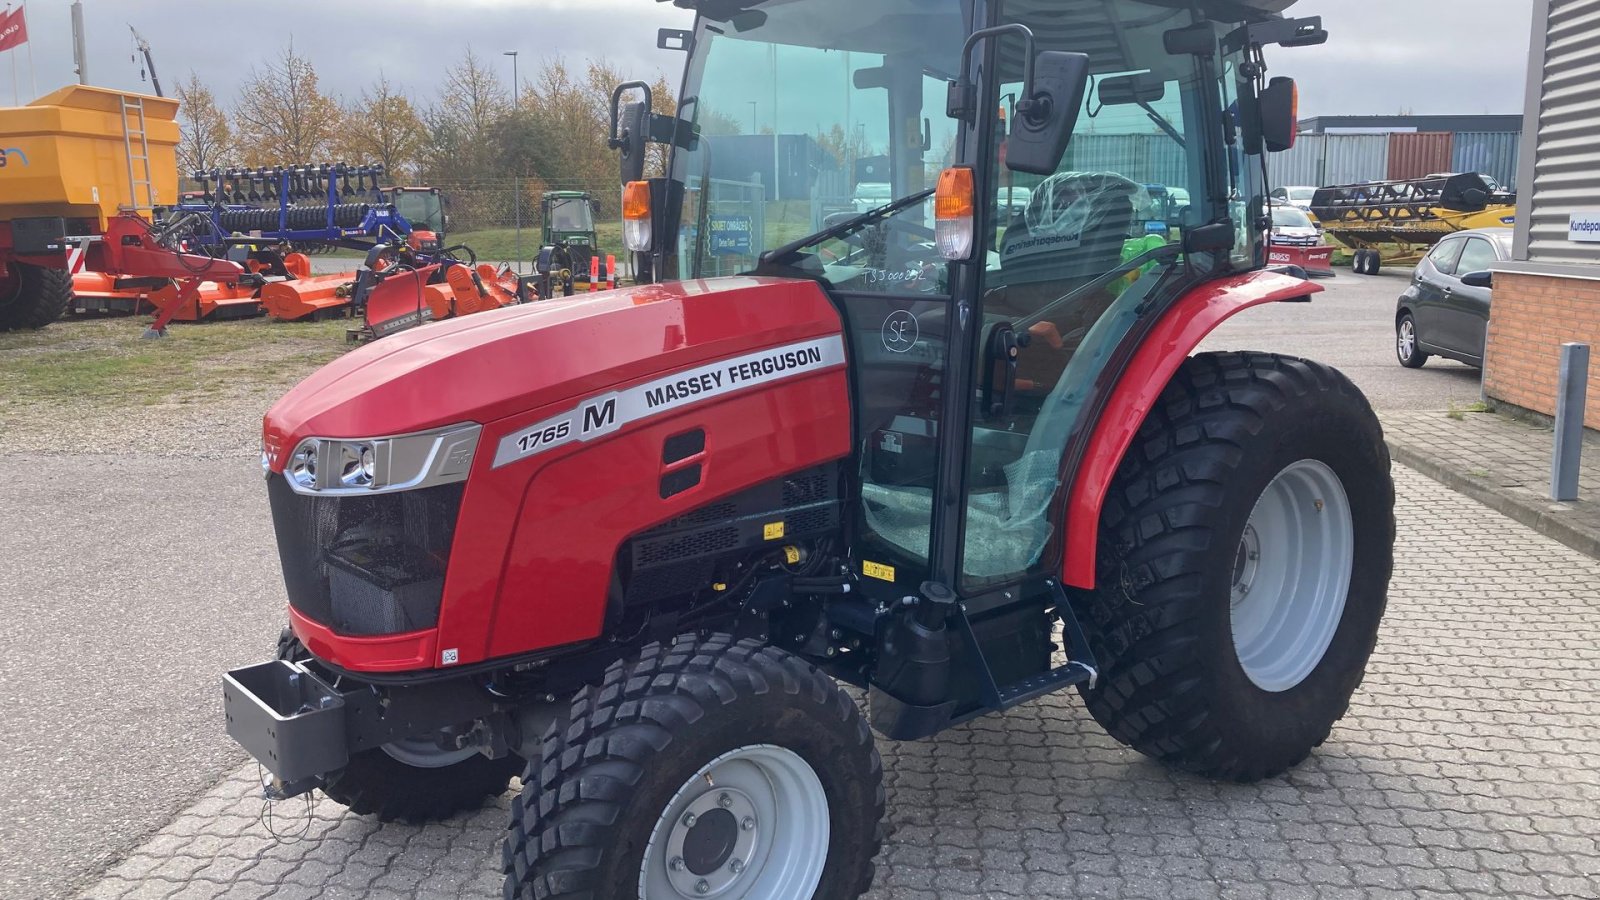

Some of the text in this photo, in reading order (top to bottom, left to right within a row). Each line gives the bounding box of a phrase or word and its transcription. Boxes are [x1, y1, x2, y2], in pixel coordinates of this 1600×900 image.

[1570, 219, 1600, 235] Kundepa
[889, 320, 908, 342] SE
[517, 346, 822, 452] 1765 M MASSEY FERGUSON
